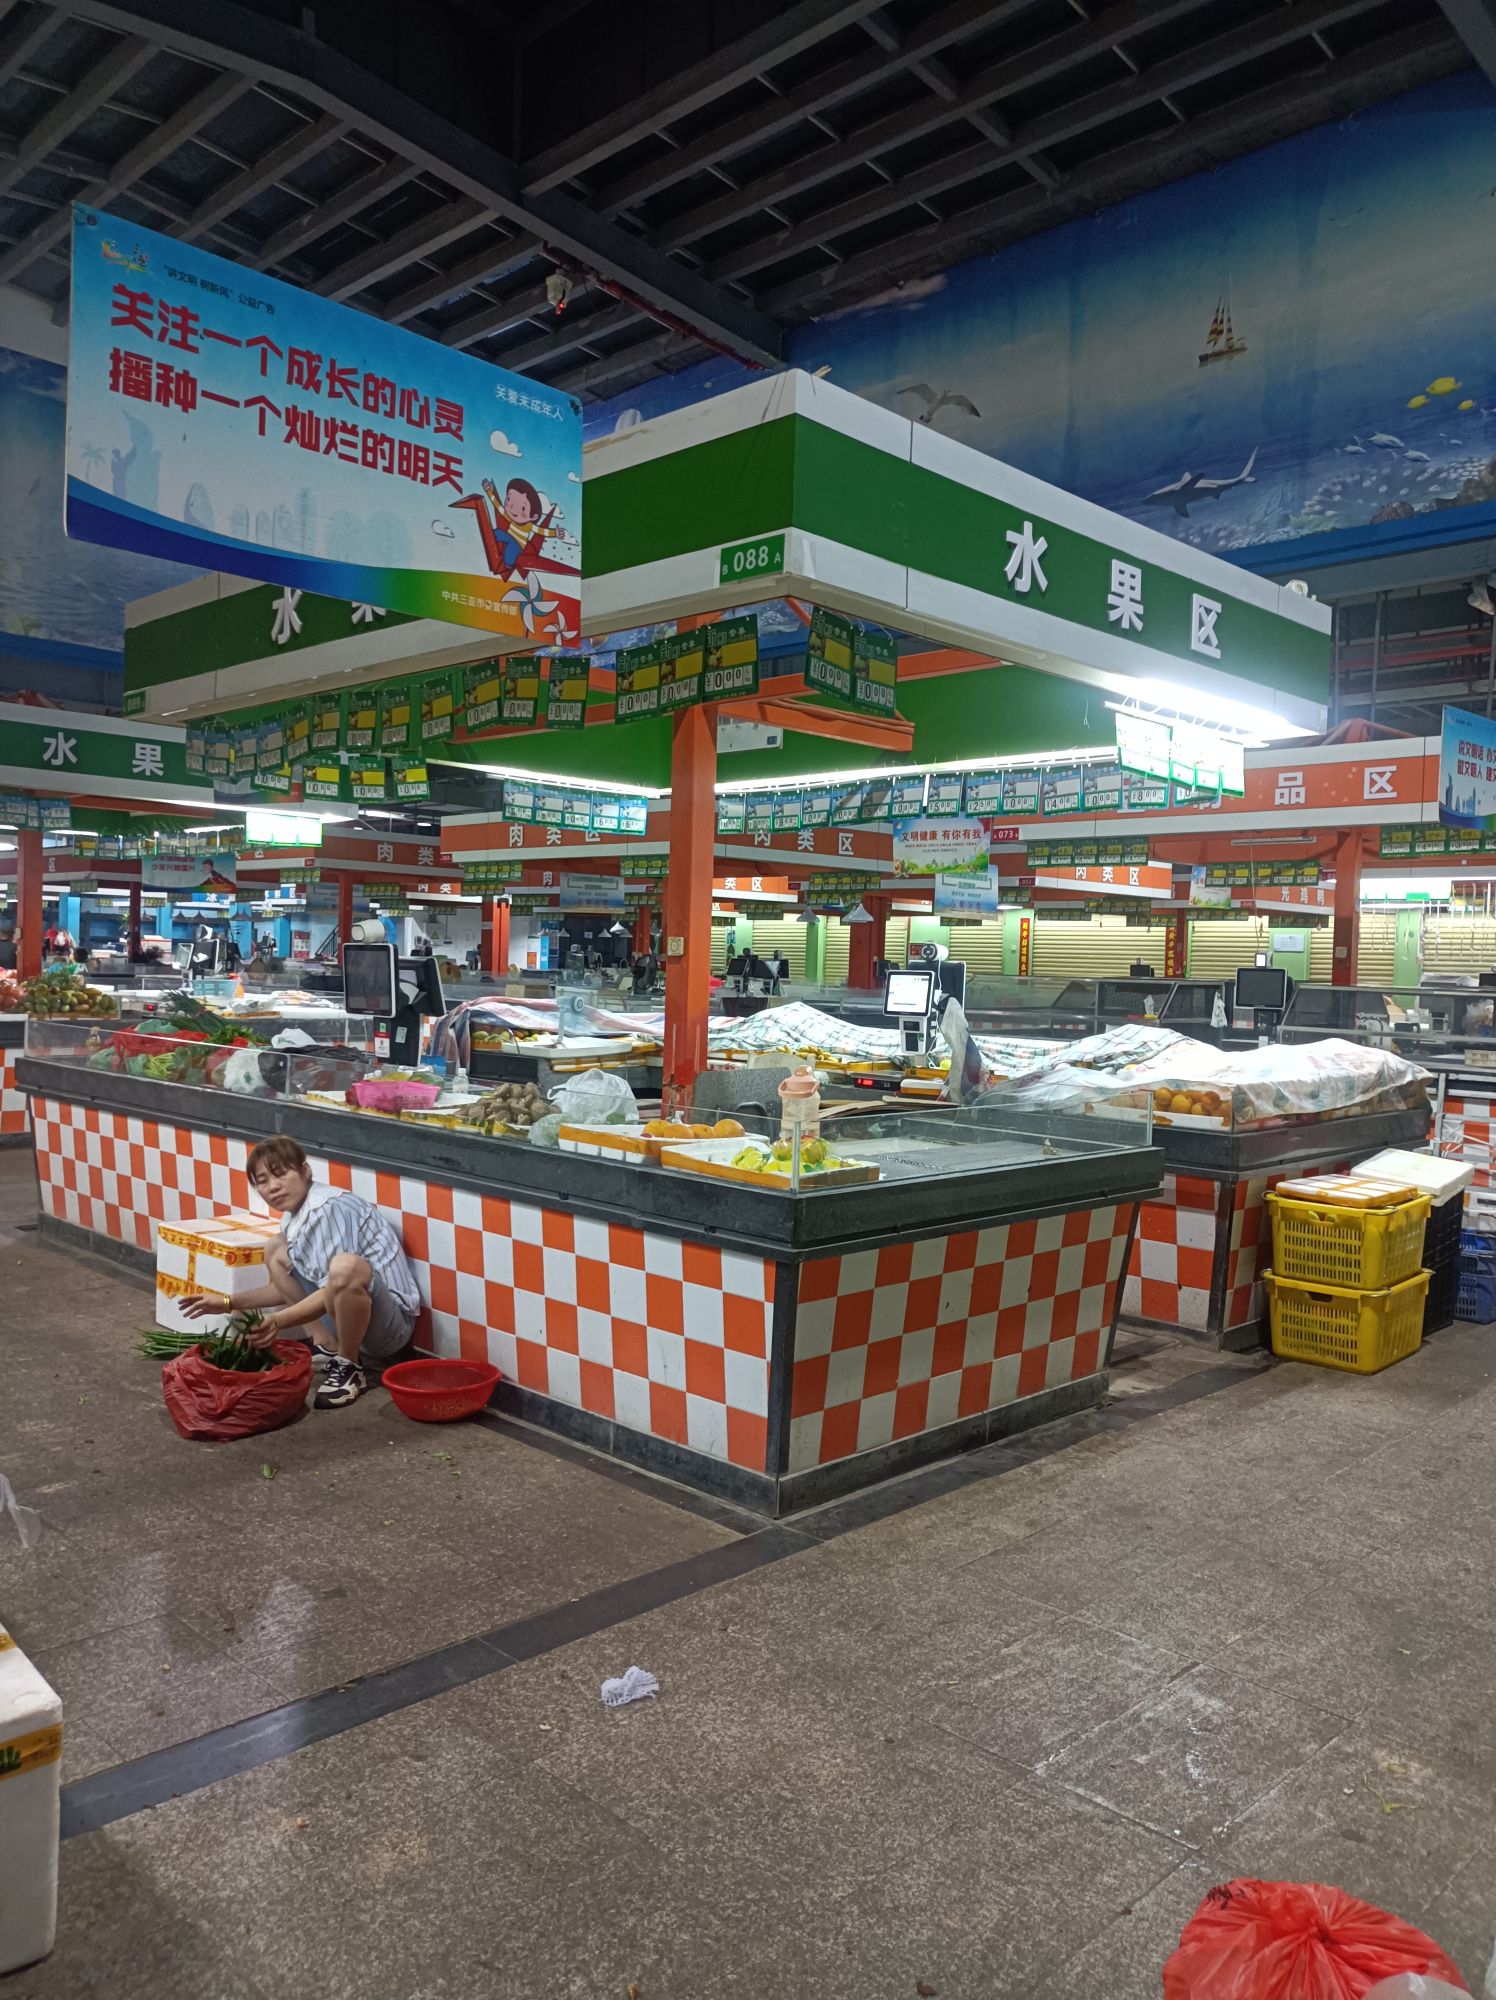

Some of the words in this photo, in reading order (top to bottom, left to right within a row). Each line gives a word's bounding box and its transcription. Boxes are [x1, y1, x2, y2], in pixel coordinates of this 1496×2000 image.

[110, 283, 465, 442] 关注一个成长的心灵
[108, 347, 465, 495] 播种一个灿烂的明天
[495, 386, 564, 423] 关爱未成年人
[722, 564, 728, 575] B
[733, 545, 769, 572] 088
[773, 552, 781, 563] A
[42, 731, 165, 777] 水果
[902, 831, 938, 841] 文明健康
[942, 829, 982, 840] 有你有我
[998, 829, 1014, 839] 073
[377, 841, 434, 867] 肉类
